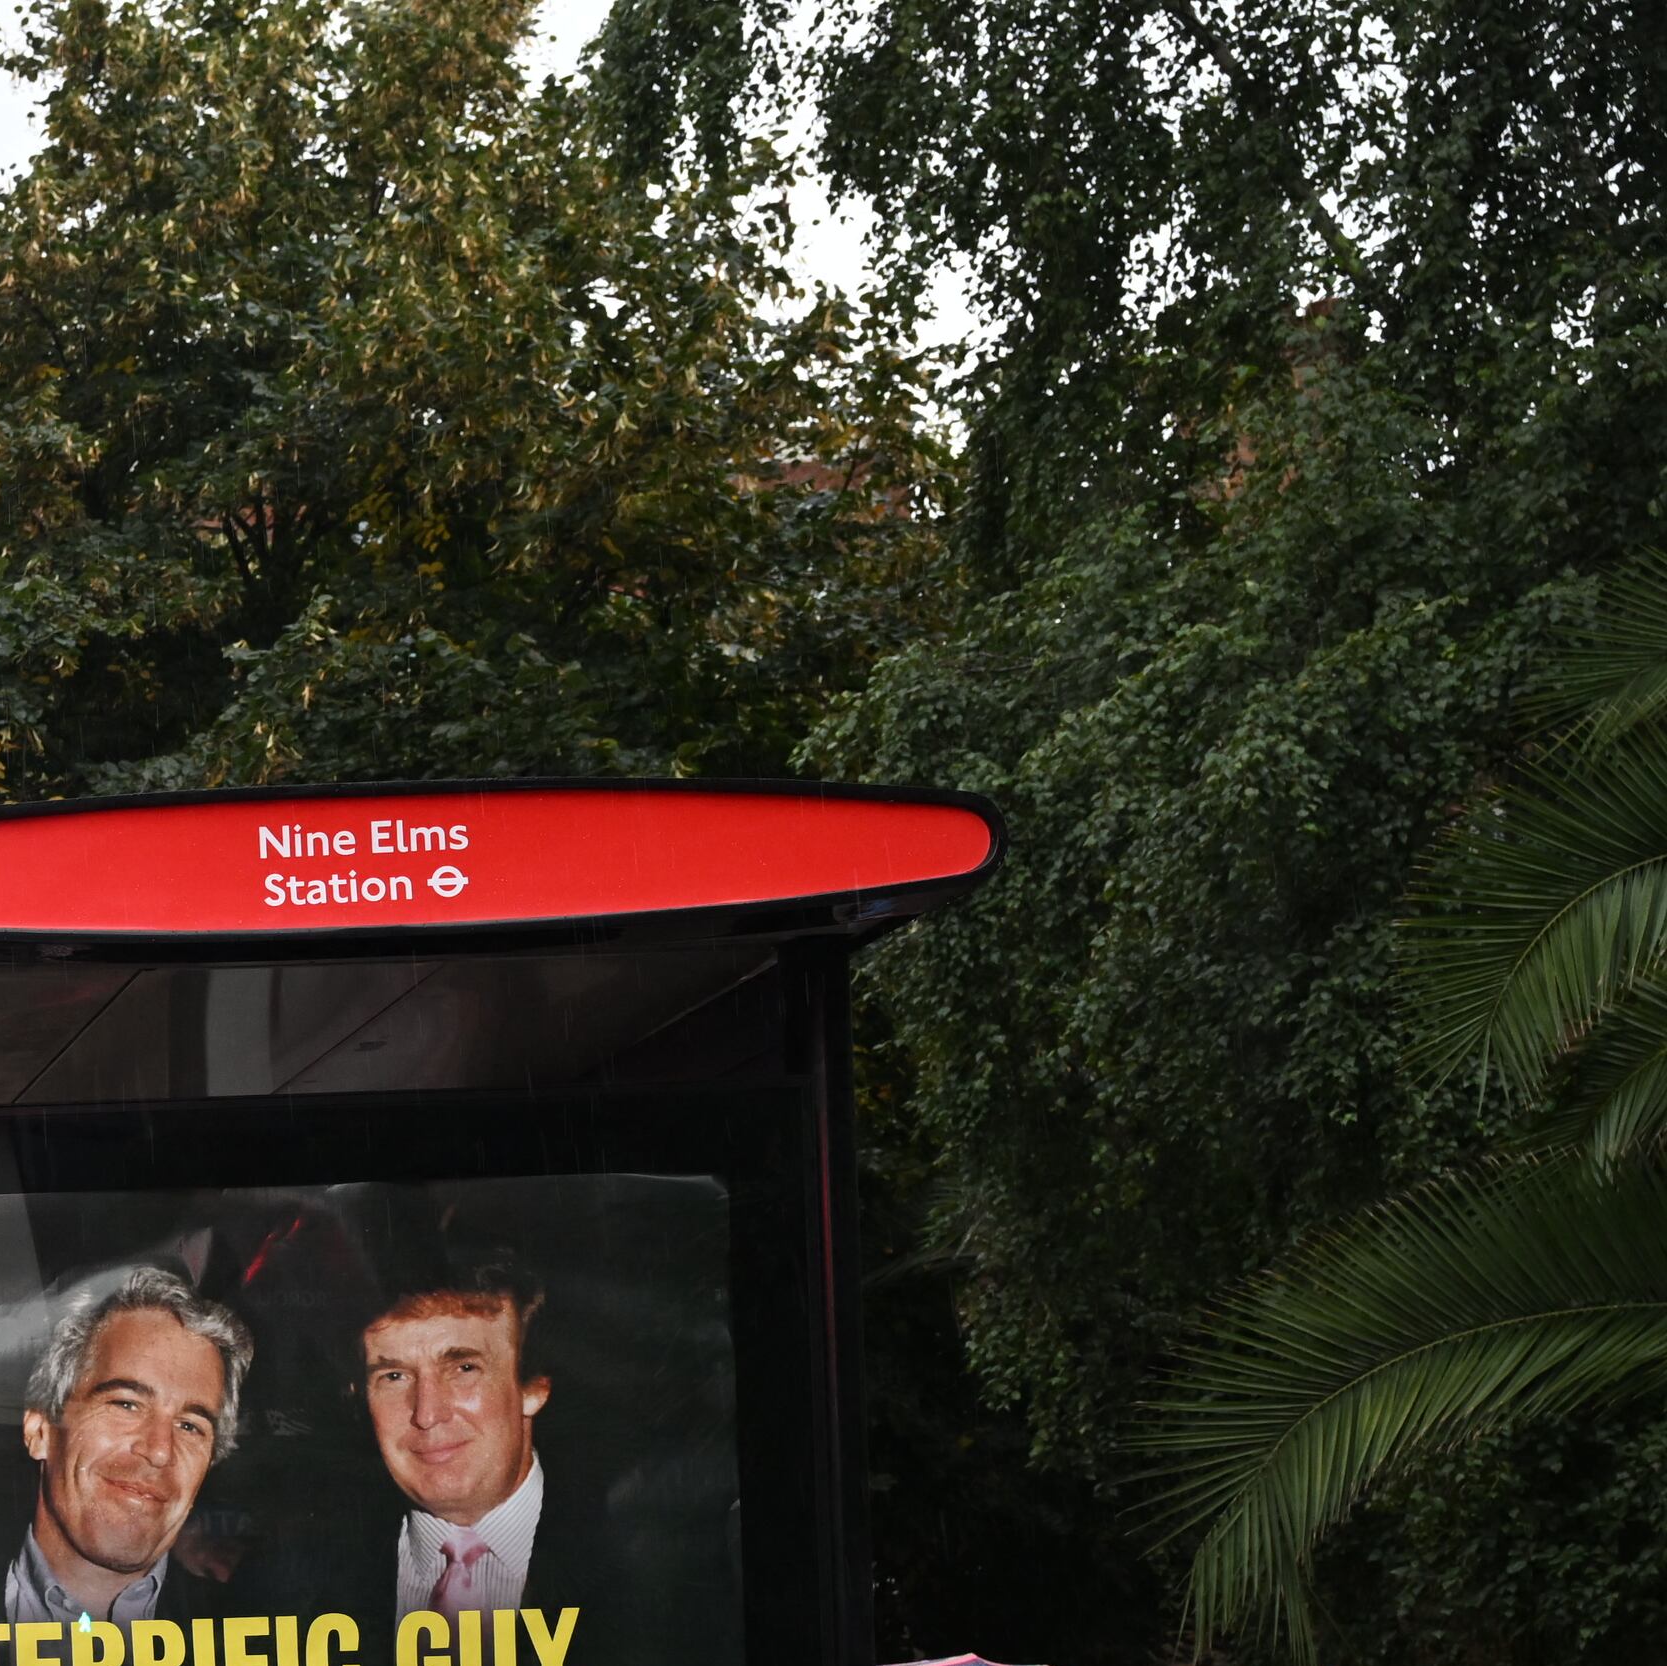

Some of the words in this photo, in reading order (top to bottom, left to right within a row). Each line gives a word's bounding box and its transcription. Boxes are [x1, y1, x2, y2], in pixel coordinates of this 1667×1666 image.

[258, 825, 356, 859] Nine
[371, 820, 469, 854] Elms
[264, 869, 413, 907] Station
